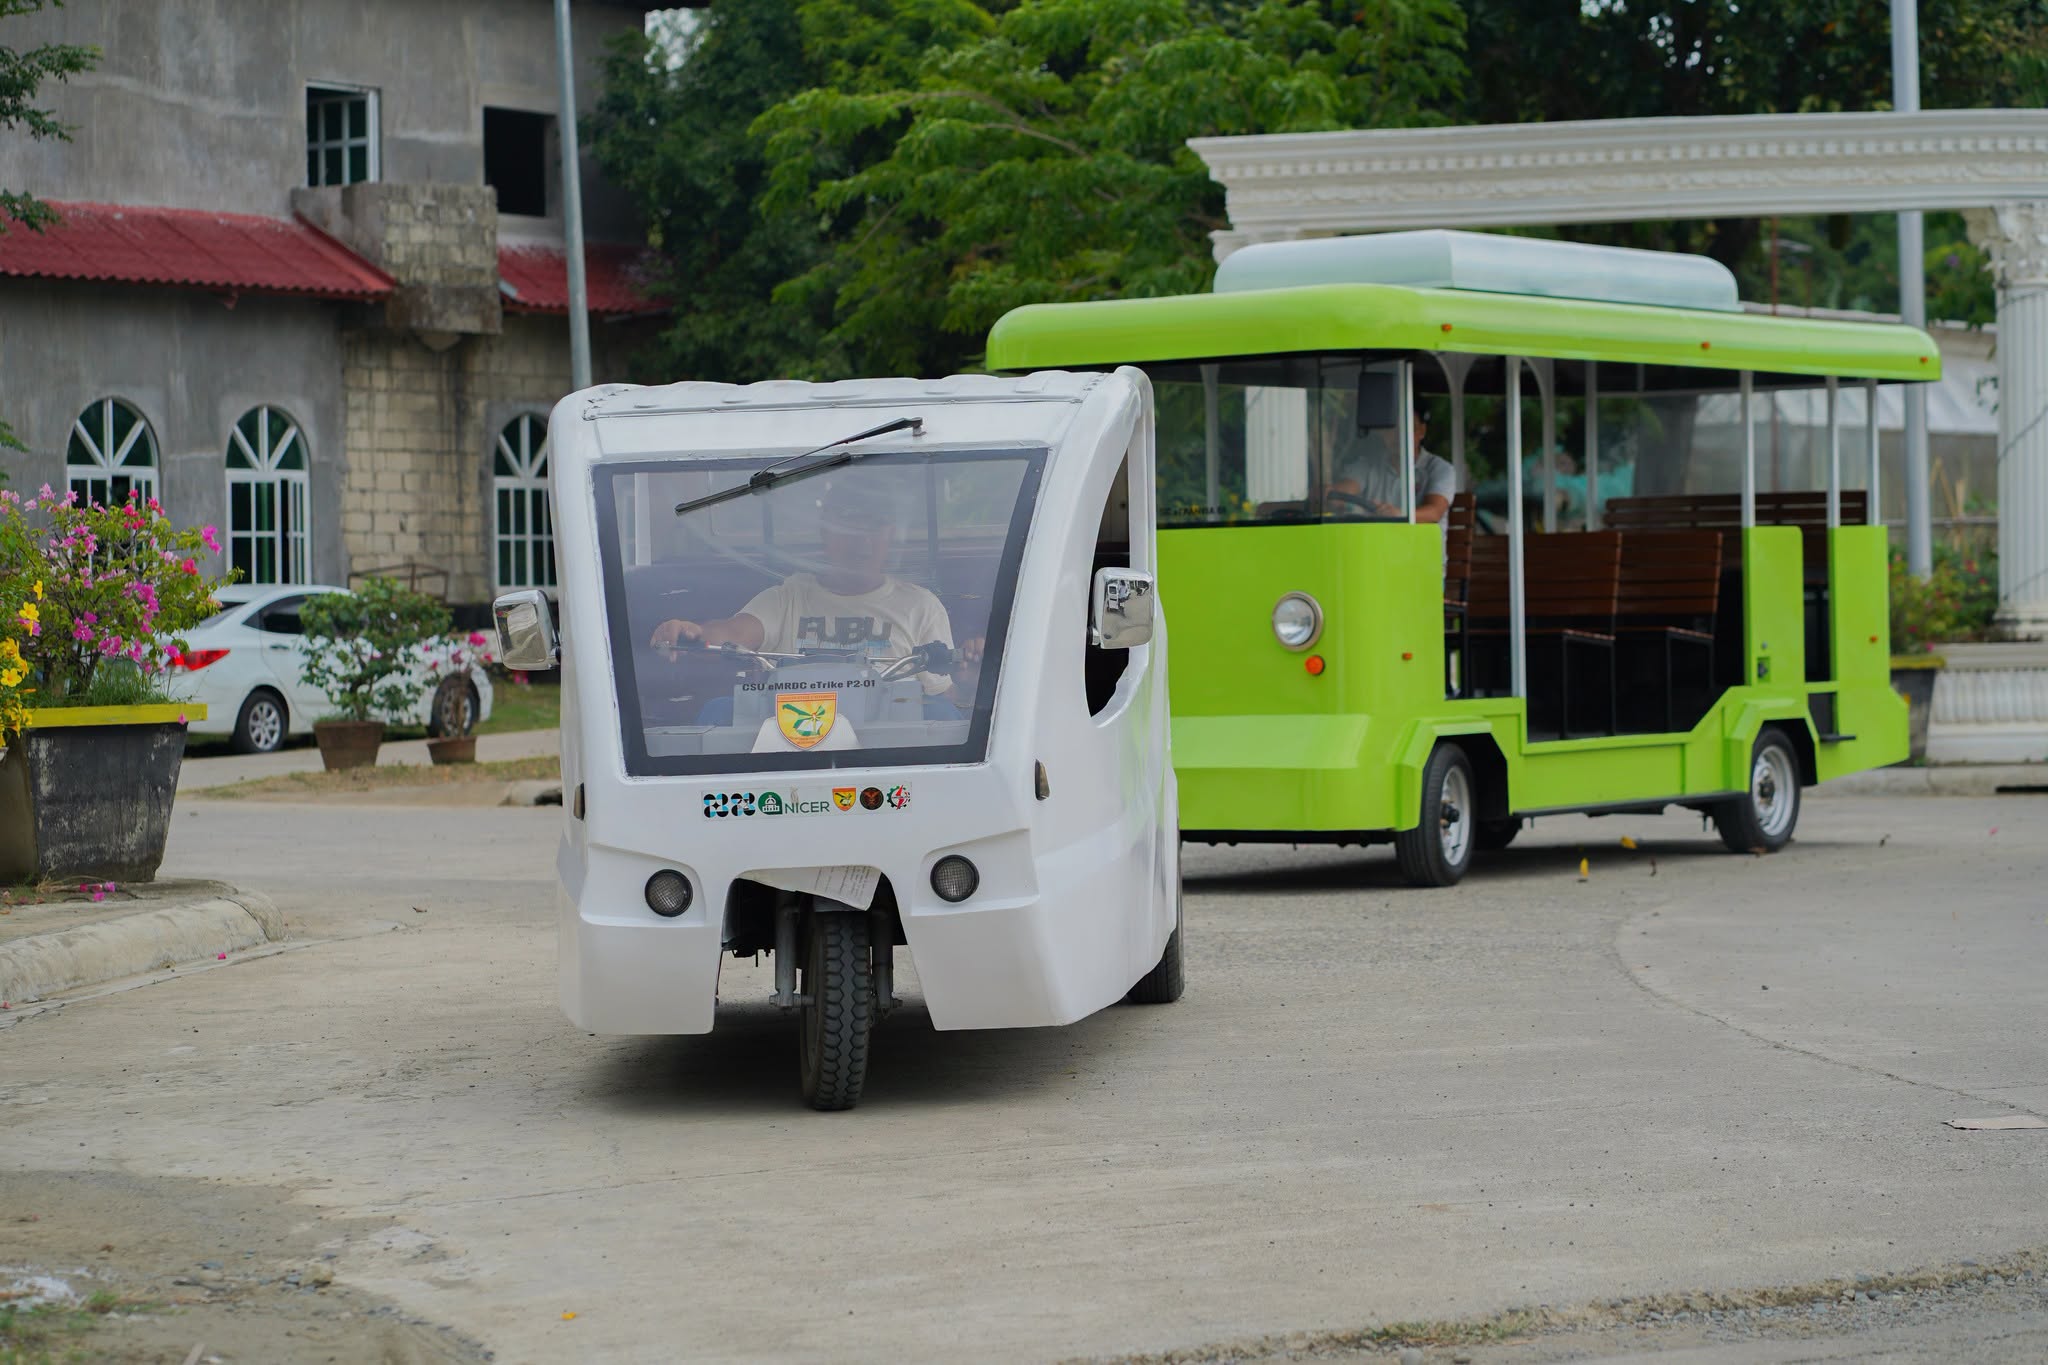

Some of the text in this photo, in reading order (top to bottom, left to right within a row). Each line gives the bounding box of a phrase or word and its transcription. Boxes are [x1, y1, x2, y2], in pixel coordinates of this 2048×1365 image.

[742, 679, 875, 691] CSU eMRDC eTrike P2-01
[784, 801, 831, 814] NICER
